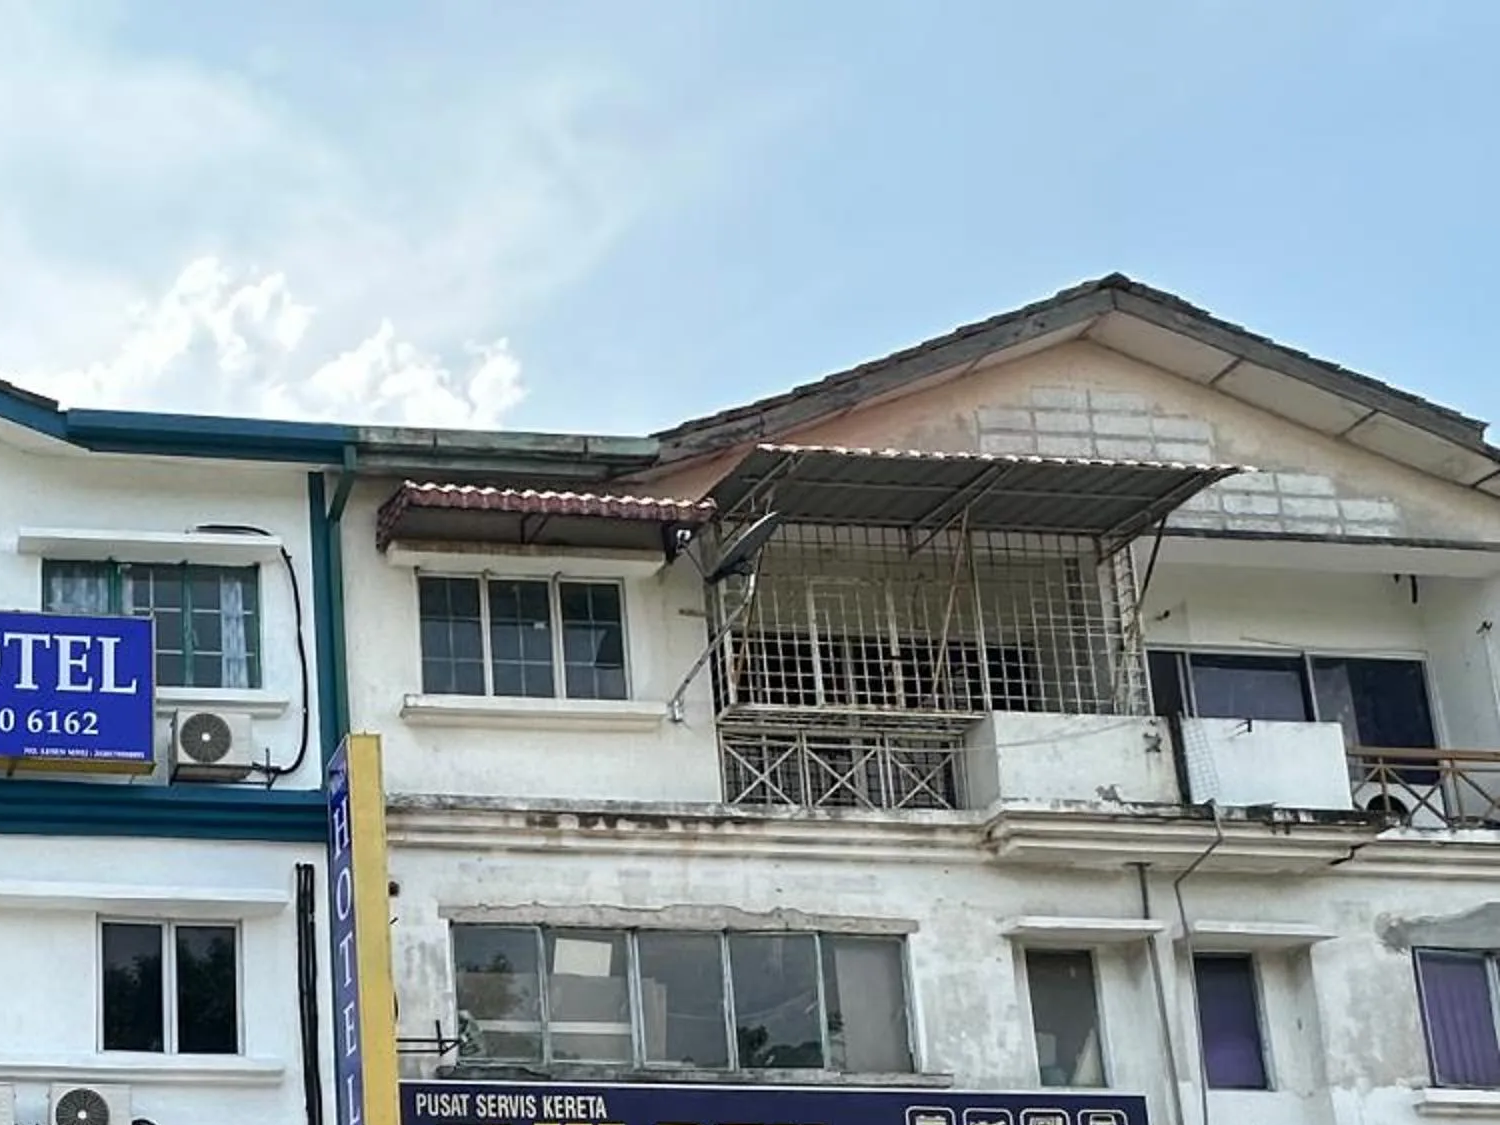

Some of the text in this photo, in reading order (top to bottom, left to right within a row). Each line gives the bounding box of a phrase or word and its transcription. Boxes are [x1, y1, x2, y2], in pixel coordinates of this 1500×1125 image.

[26, 707, 100, 737] 6162
[416, 1092, 608, 1121] PUSAT SERVIS KERETA
